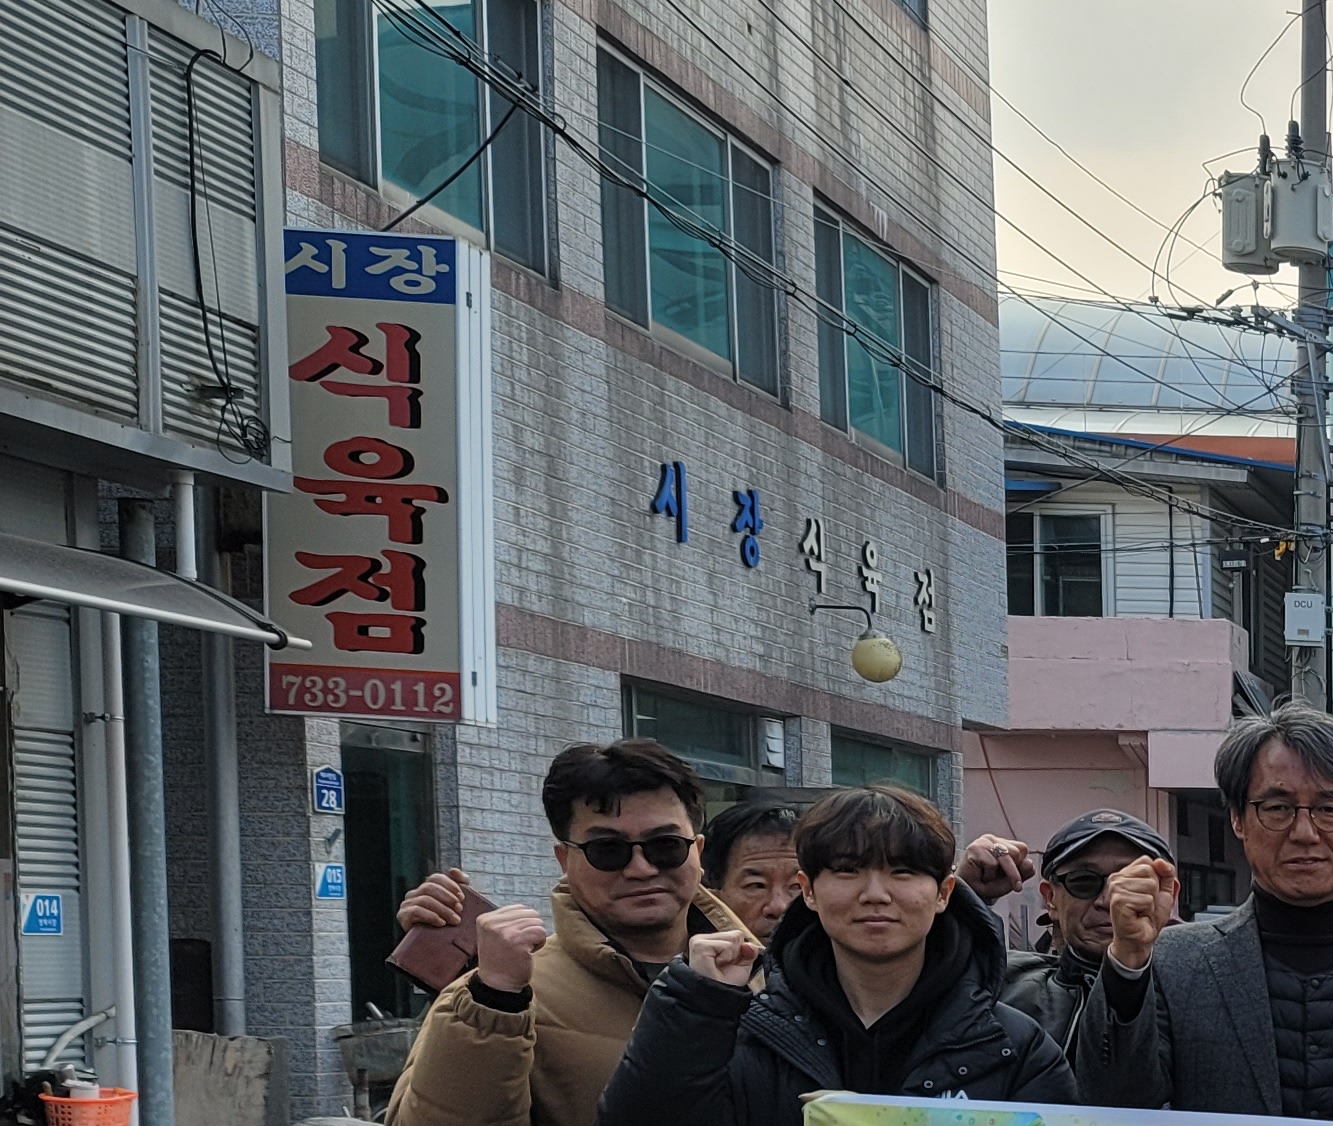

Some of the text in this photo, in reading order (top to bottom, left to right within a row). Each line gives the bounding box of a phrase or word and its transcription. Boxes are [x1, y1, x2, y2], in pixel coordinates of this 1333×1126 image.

[285, 239, 449, 294] 시장
[288, 323, 449, 654] 식육점
[651, 461, 936, 633] 시장 식육점
[1294, 600, 1313, 608] DCU
[281, 673, 455, 715] 733-0112
[321, 789, 337, 808] 28
[326, 868, 342, 884] 015
[36, 899, 58, 917] 014
